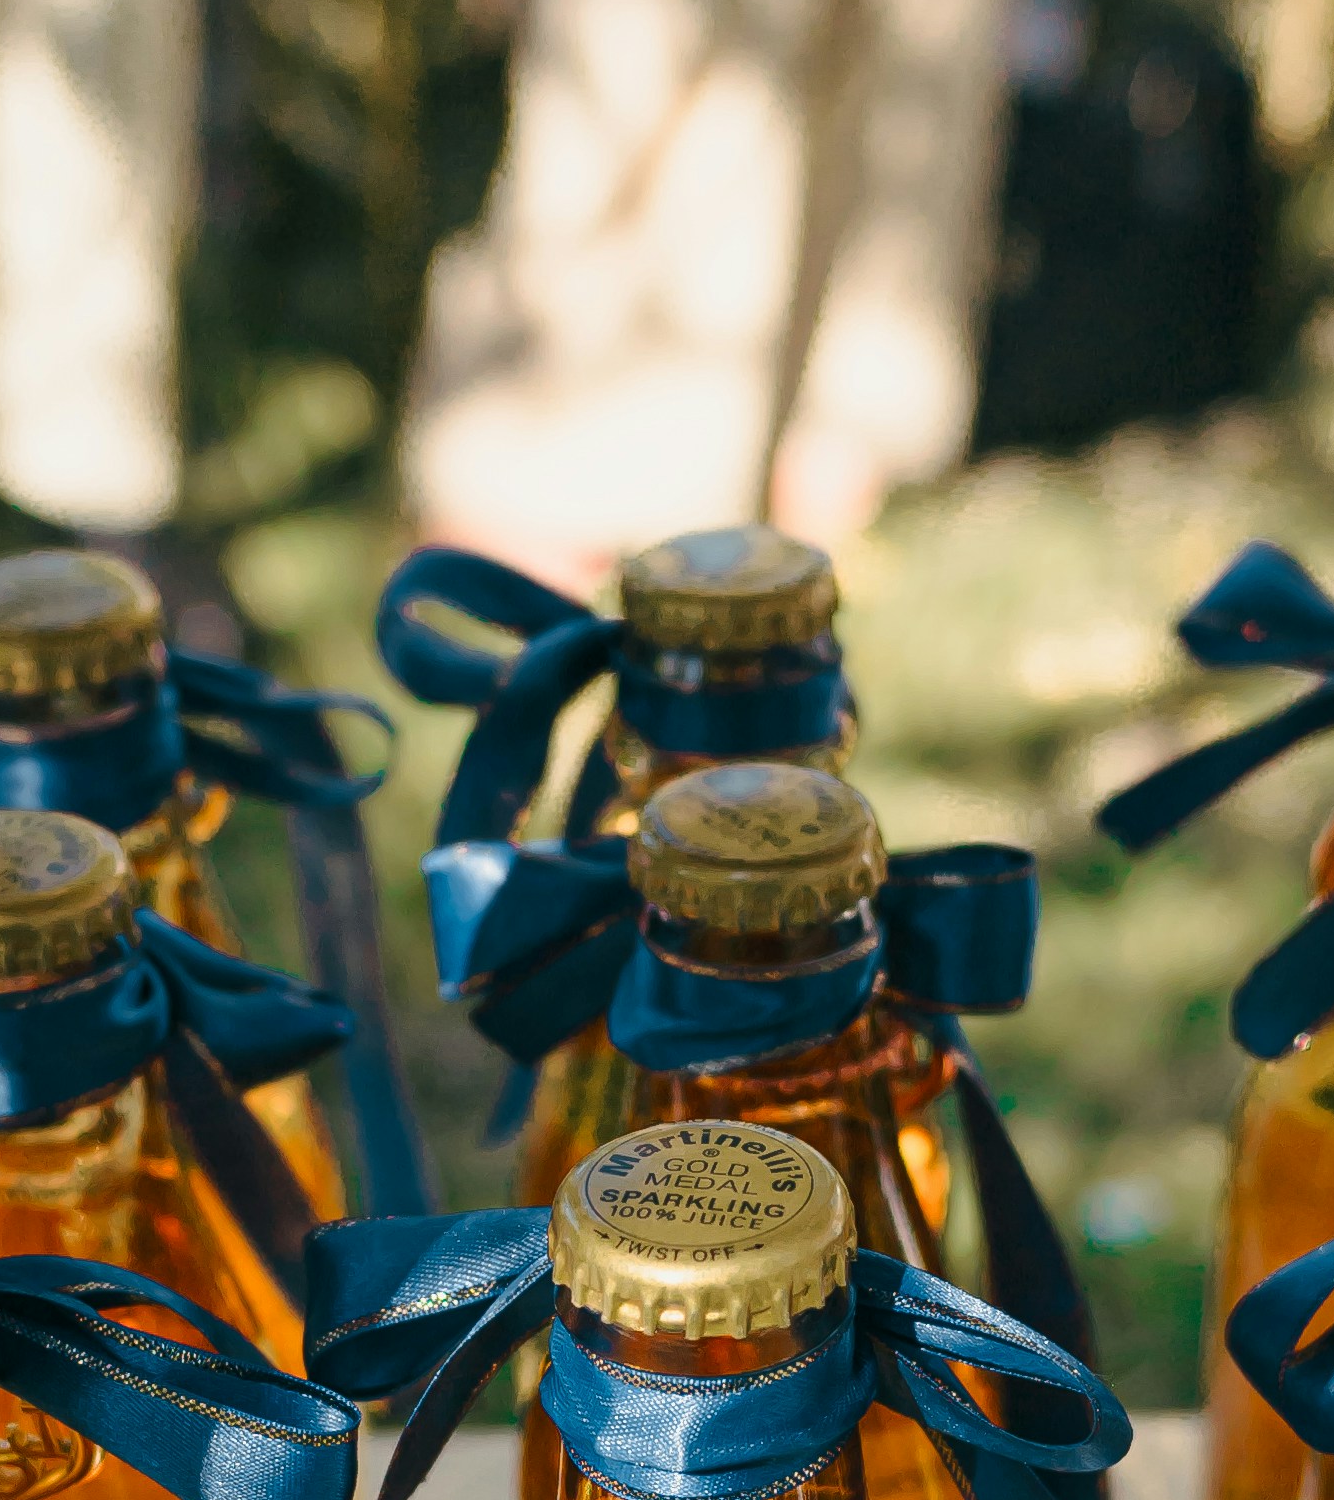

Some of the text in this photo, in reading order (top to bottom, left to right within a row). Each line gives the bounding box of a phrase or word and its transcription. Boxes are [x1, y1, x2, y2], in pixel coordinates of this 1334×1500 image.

[598, 1128, 804, 1194] Martinelli's
[663, 1157, 750, 1177] GOLD
[643, 1171, 759, 1195] MEDAL
[599, 1188, 785, 1218] SPARKLING
[609, 1203, 765, 1230] 100% JUICE
[614, 1235, 737, 1263] TWIST OFF
